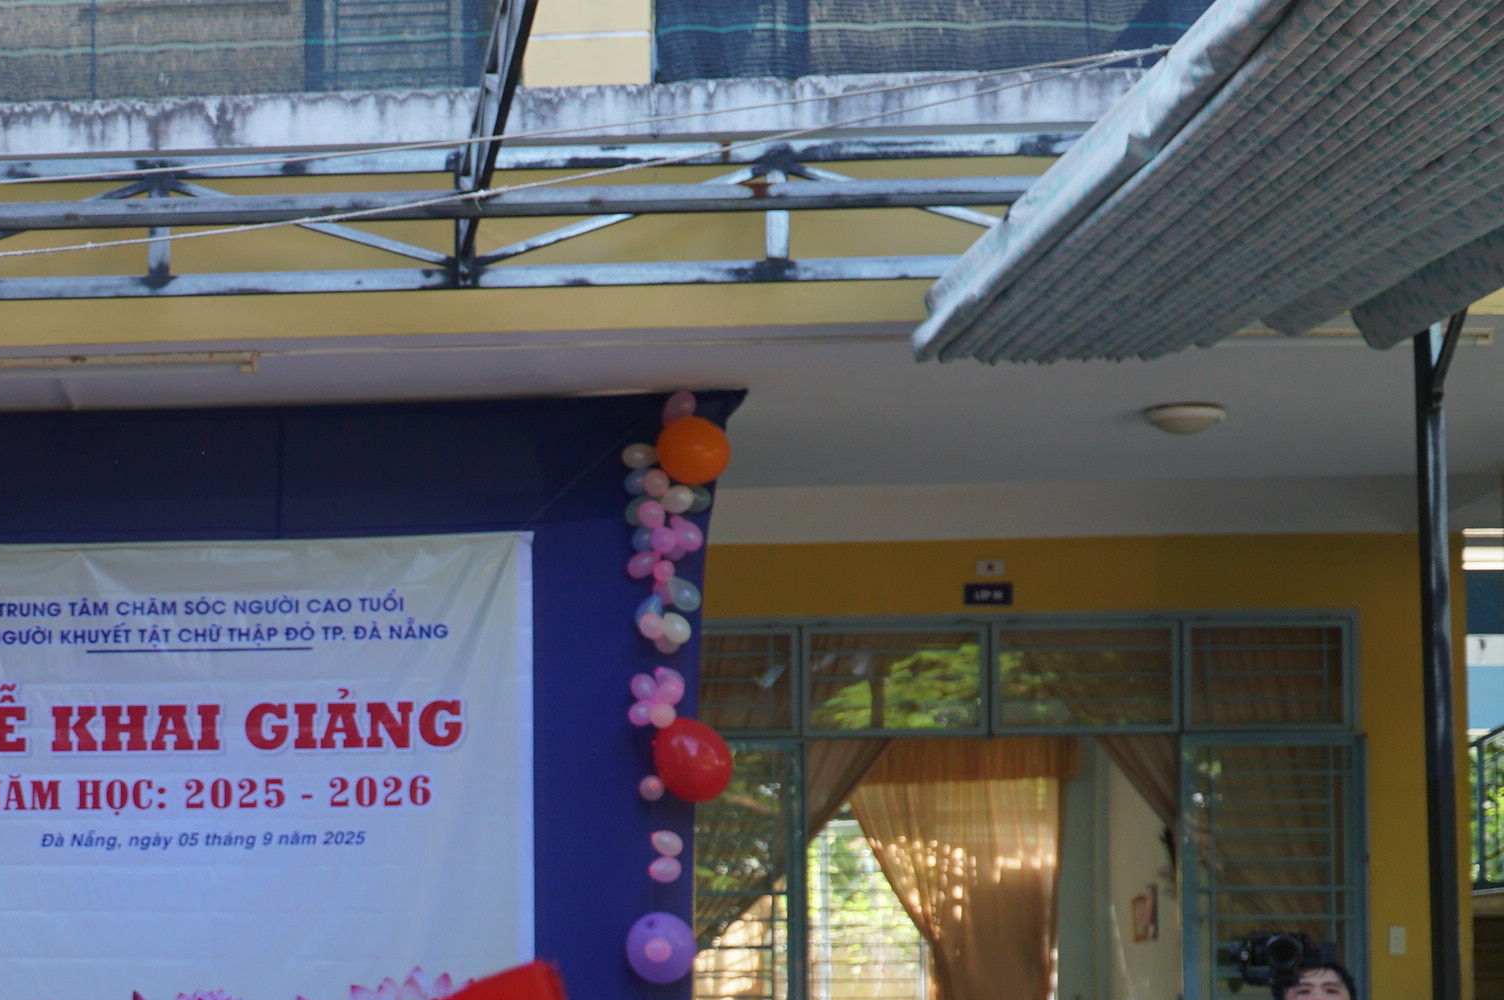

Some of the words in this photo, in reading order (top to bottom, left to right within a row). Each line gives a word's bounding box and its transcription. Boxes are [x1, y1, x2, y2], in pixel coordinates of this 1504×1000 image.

[68, 598, 109, 617] TÂM
[115, 598, 177, 617] CHĂM
[184, 596, 226, 616] SÓC
[233, 595, 300, 615] NGƯỜI
[306, 598, 353, 613] CAO
[359, 589, 405, 612] TUỔI
[60, 623, 132, 644] KHUYẾT
[138, 625, 172, 648] TẬT
[178, 625, 222, 643] CHỮ
[228, 623, 278, 646] THẬP
[285, 621, 315, 641] ĐỎ
[322, 626, 346, 641] TP.
[353, 621, 382, 640] ĐÀ
[389, 617, 449, 640] NẴNG
[51, 703, 221, 753] KHAI
[244, 688, 464, 751] GIẢNG
[77, 779, 167, 816] HỌC:
[184, 778, 287, 810] 2025
[329, 775, 432, 807] 2026
[40, 832, 65, 848] Đà
[69, 828, 123, 850] Nẵng,
[127, 830, 174, 850] ngày
[177, 831, 200, 848] 05
[204, 831, 257, 850] tháng
[262, 831, 274, 846] 9
[277, 830, 318, 846] năm
[322, 830, 366, 846] 2025
